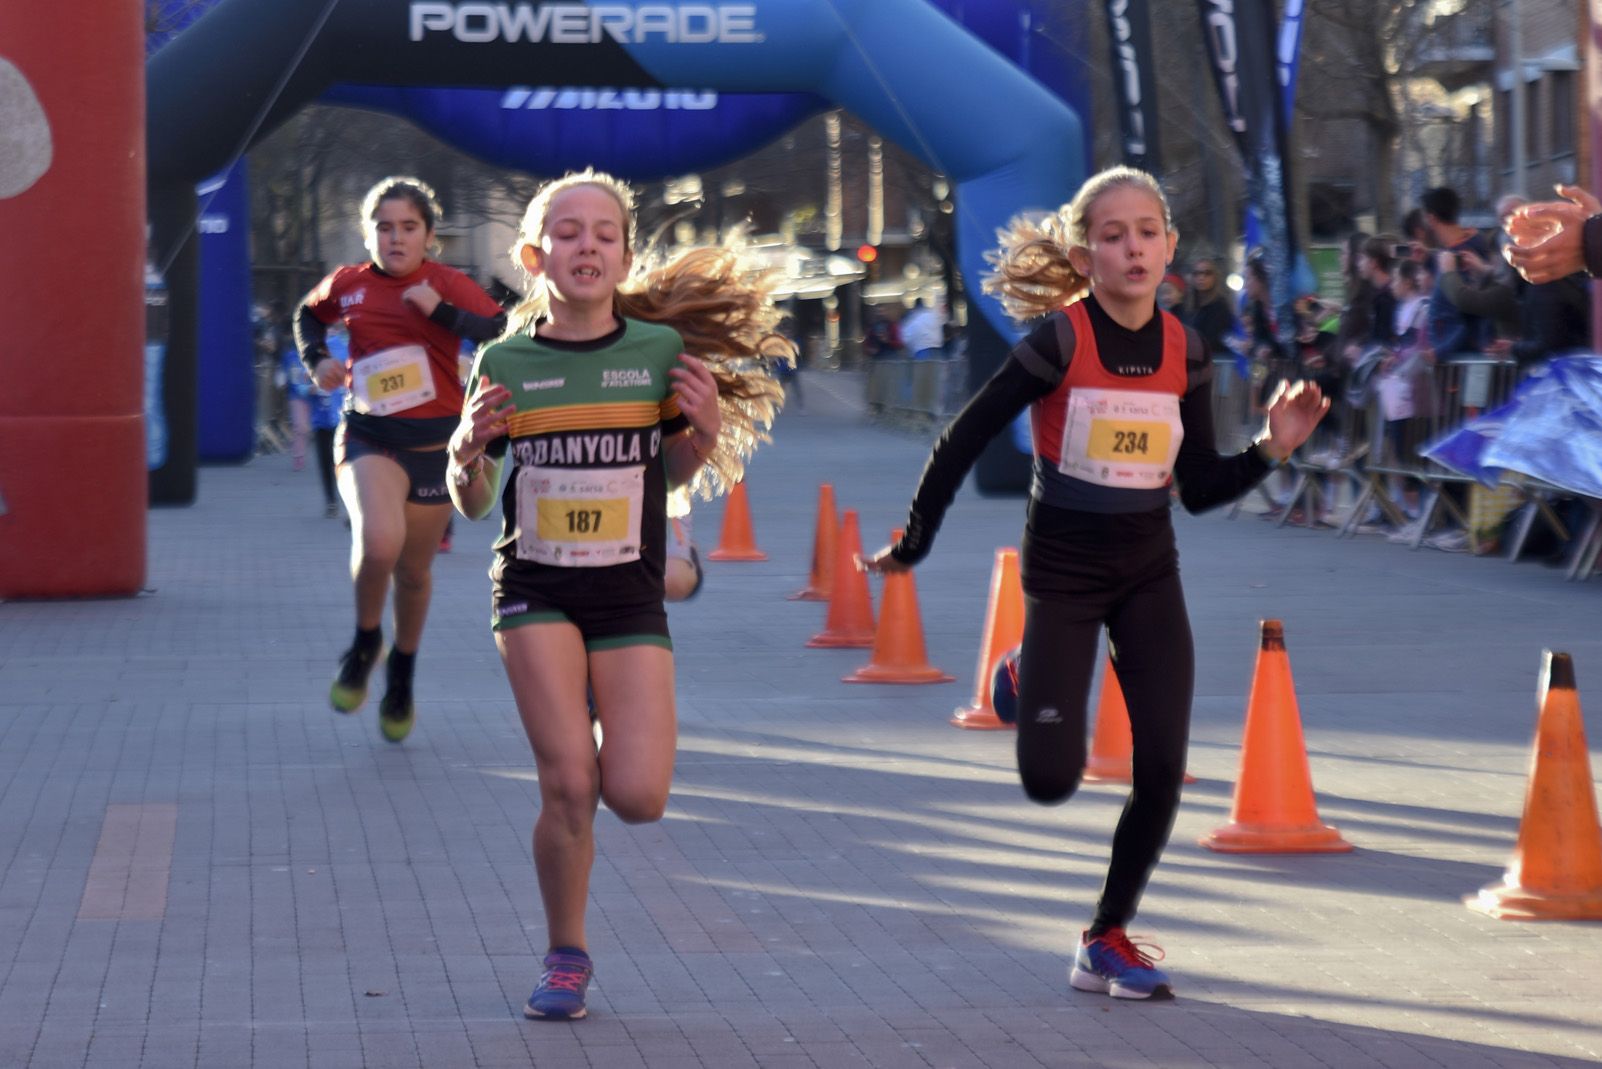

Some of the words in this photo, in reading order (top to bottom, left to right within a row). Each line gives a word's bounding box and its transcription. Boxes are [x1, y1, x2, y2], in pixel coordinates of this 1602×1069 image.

[410, 4, 757, 43] POWERADE
[602, 369, 650, 379] ESCOLA
[1118, 365, 1153, 375] KIPSTA
[380, 374, 404, 393] 237
[1112, 431, 1149, 455] 234
[565, 510, 602, 533] 187
